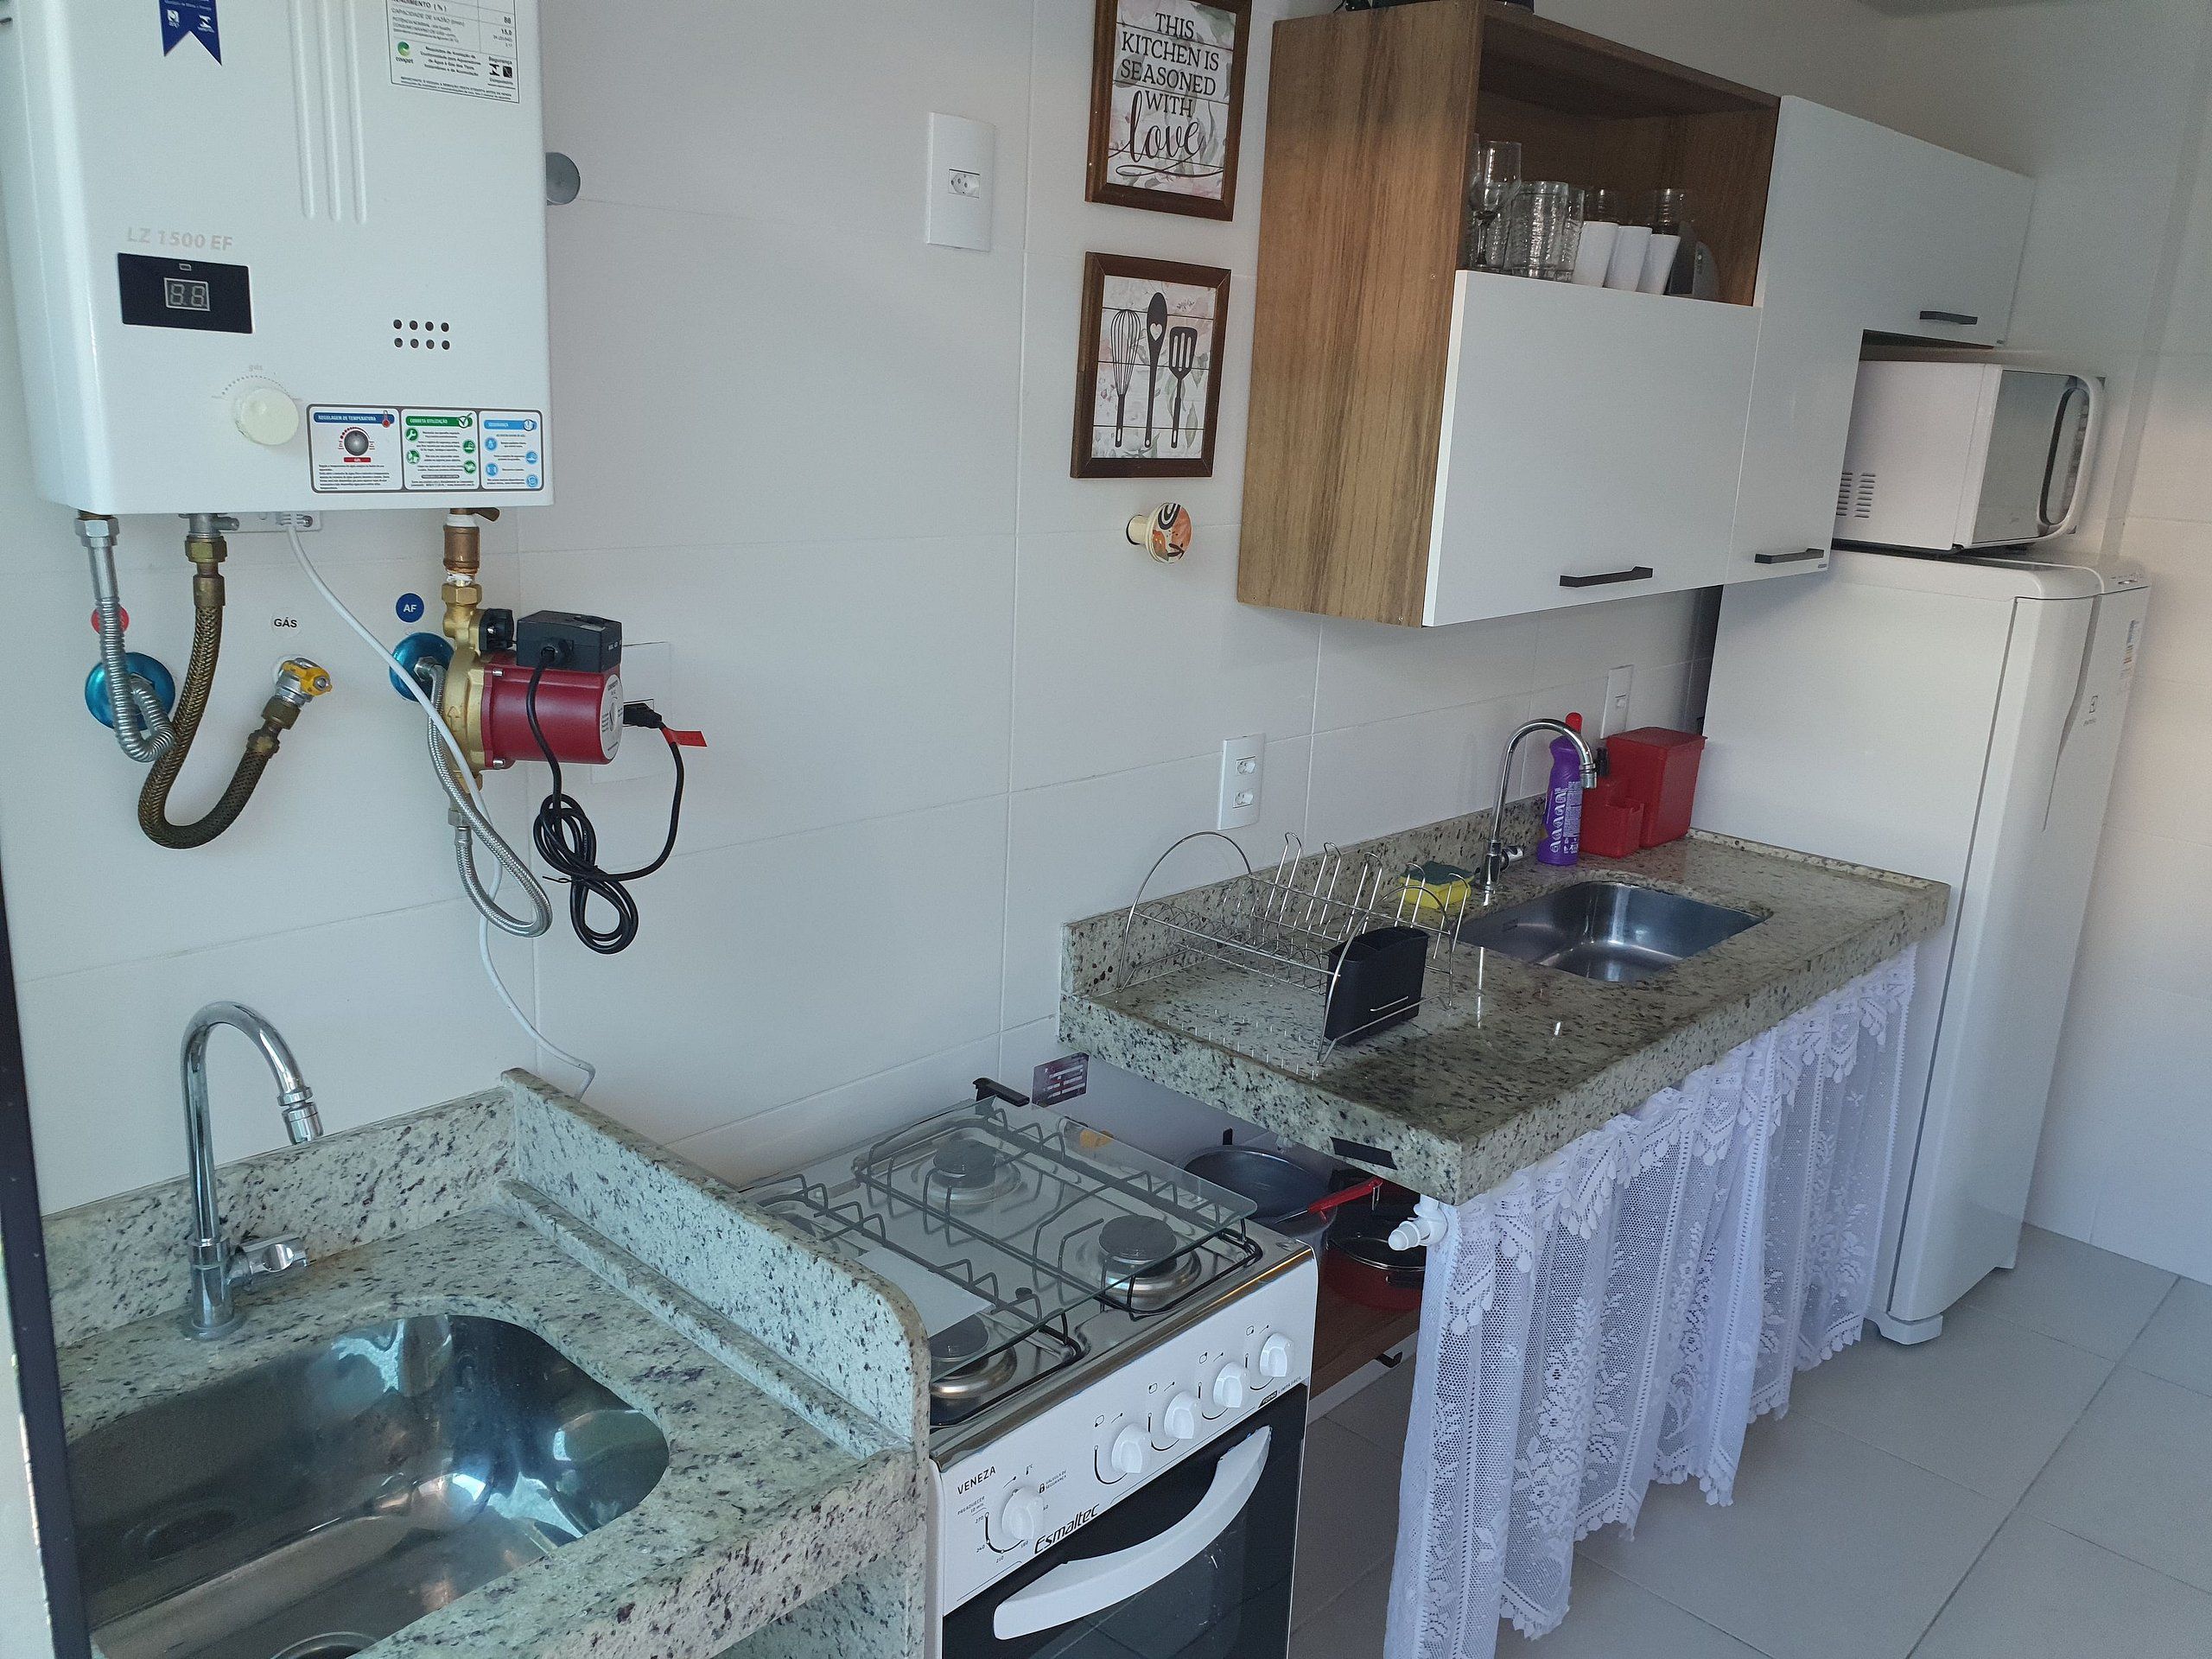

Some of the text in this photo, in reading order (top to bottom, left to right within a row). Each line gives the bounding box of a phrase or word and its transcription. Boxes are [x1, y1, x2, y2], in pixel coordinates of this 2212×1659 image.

[1155, 12, 1194, 39] THIS
[1122, 31, 1219, 71] KITCHEN IS
[1120, 59, 1216, 95] SEASONED
[1145, 91, 1193, 118] WITH
[1120, 90, 1206, 164] love
[127, 226, 233, 251] LZ 1500 EF
[274, 616, 297, 628] GÁS
[403, 604, 417, 613] AF
[957, 1465, 995, 1495] VENEZA
[1034, 1503, 1100, 1554] Esmaltec
